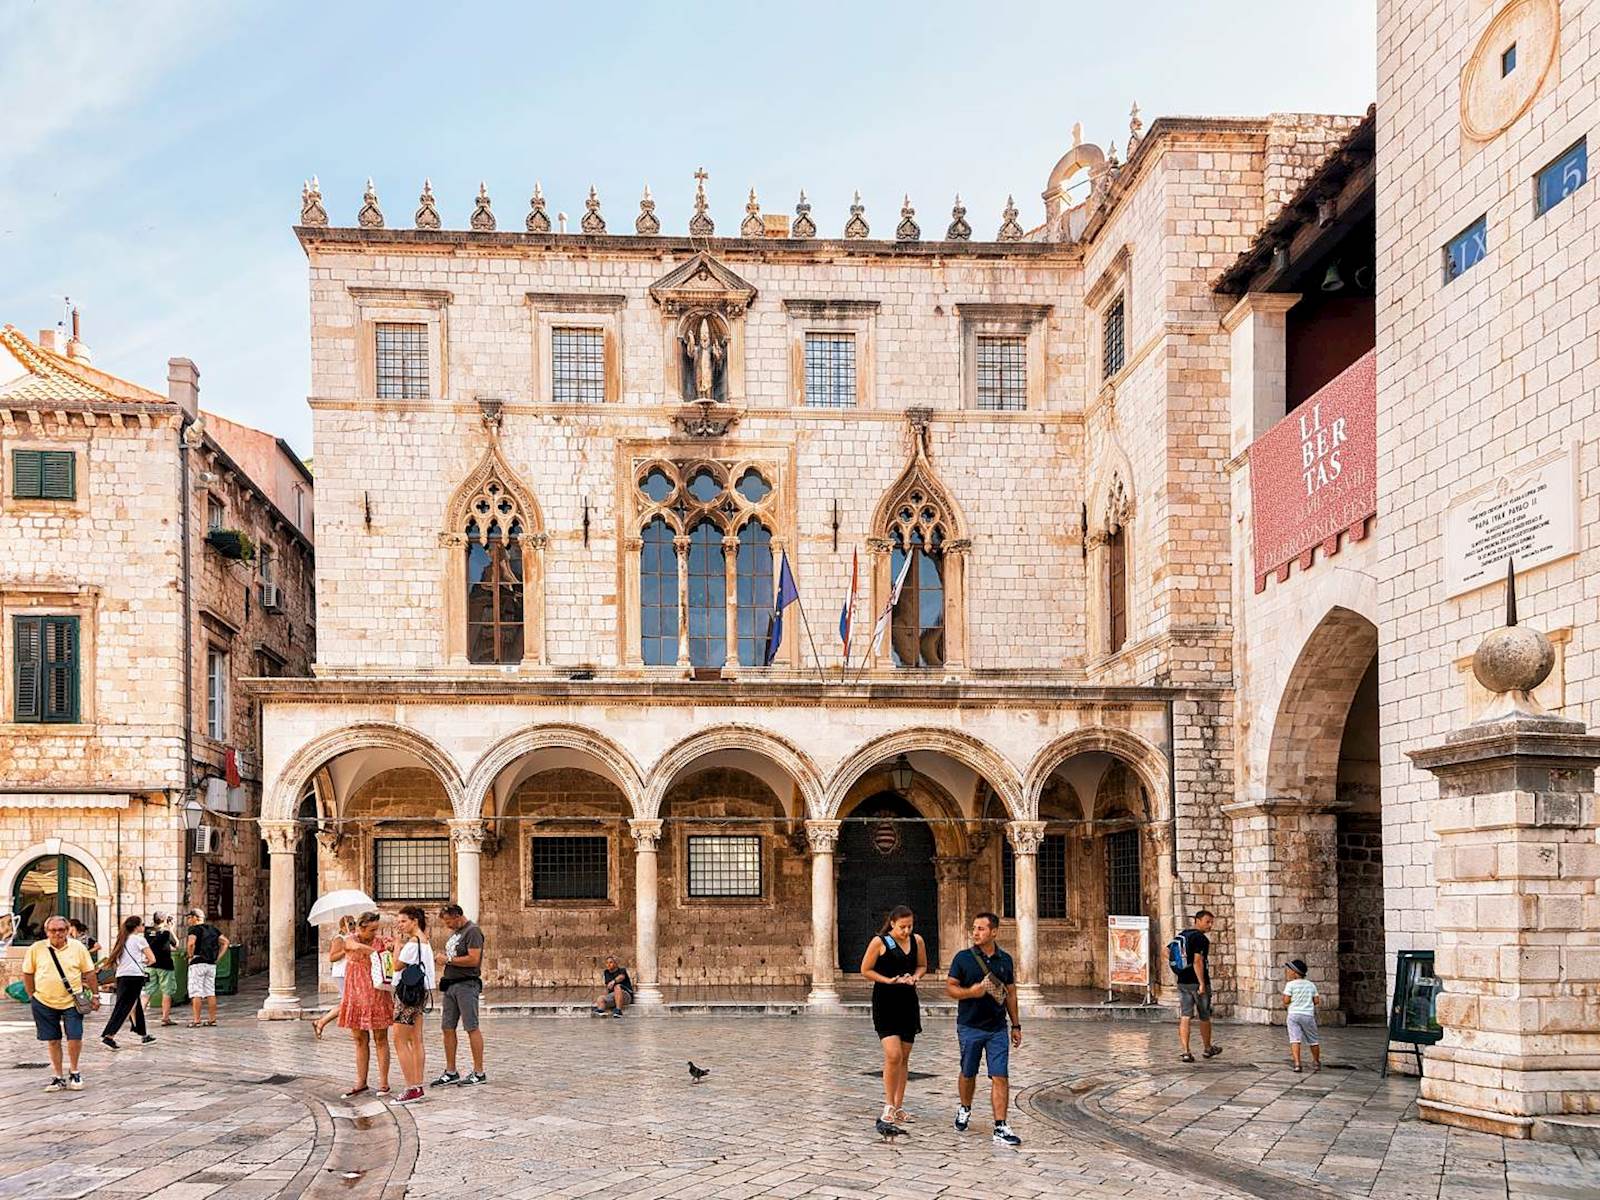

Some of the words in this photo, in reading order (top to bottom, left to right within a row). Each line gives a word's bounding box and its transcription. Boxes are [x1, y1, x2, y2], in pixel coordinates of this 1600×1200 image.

[1562, 158, 1581, 197] 5
[1460, 227, 1486, 271] IX
[1299, 402, 1321, 442] LI
[1302, 417, 1347, 470] BER
[1303, 450, 1342, 496] TAS
[1475, 517, 1489, 530] PAPA
[1491, 511, 1505, 523] IVAN
[1508, 501, 1529, 516] PAVAO
